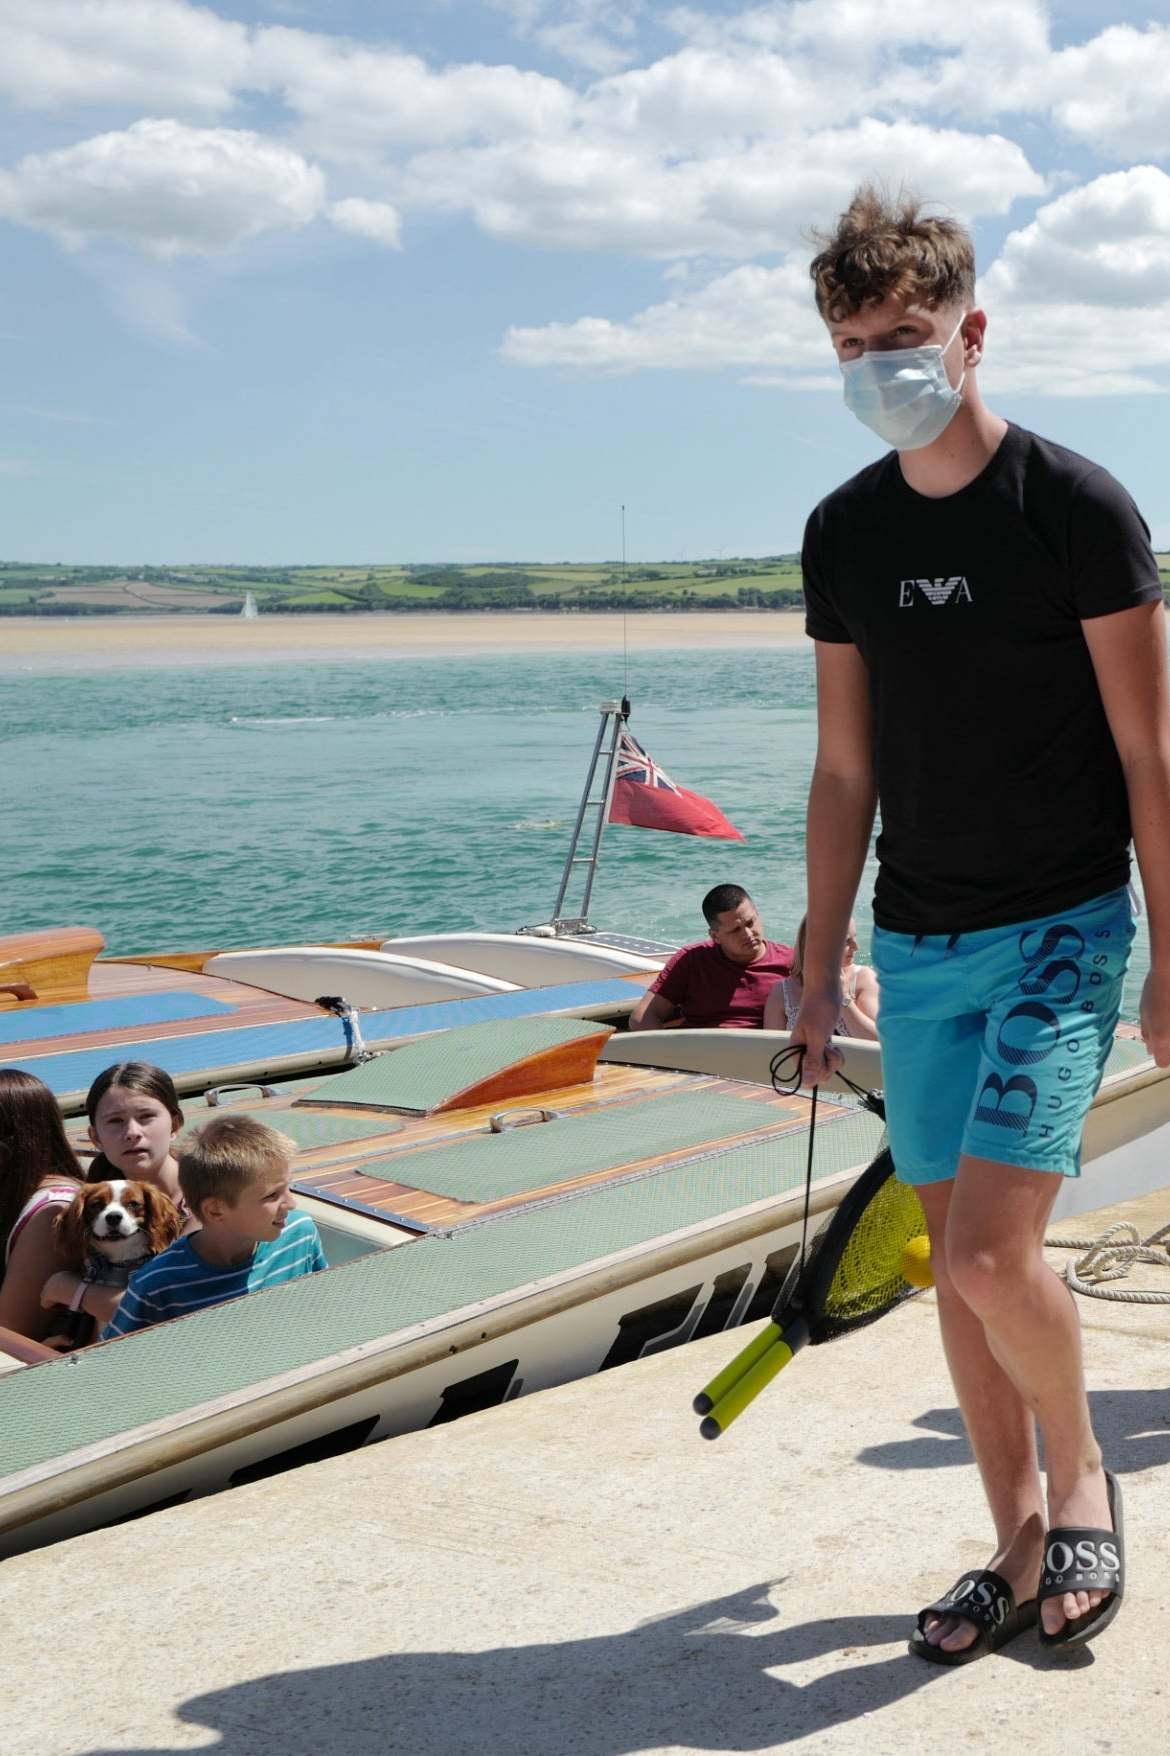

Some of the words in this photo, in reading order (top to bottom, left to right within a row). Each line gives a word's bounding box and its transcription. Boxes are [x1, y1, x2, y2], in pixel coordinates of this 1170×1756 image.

[974, 923, 1085, 1138] BOSS
[1038, 1037, 1080, 1139] HUGO
[1080, 929, 1111, 1014] BOSS
[947, 1579, 1010, 1625] OSS
[1042, 1540, 1120, 1573] OSS
